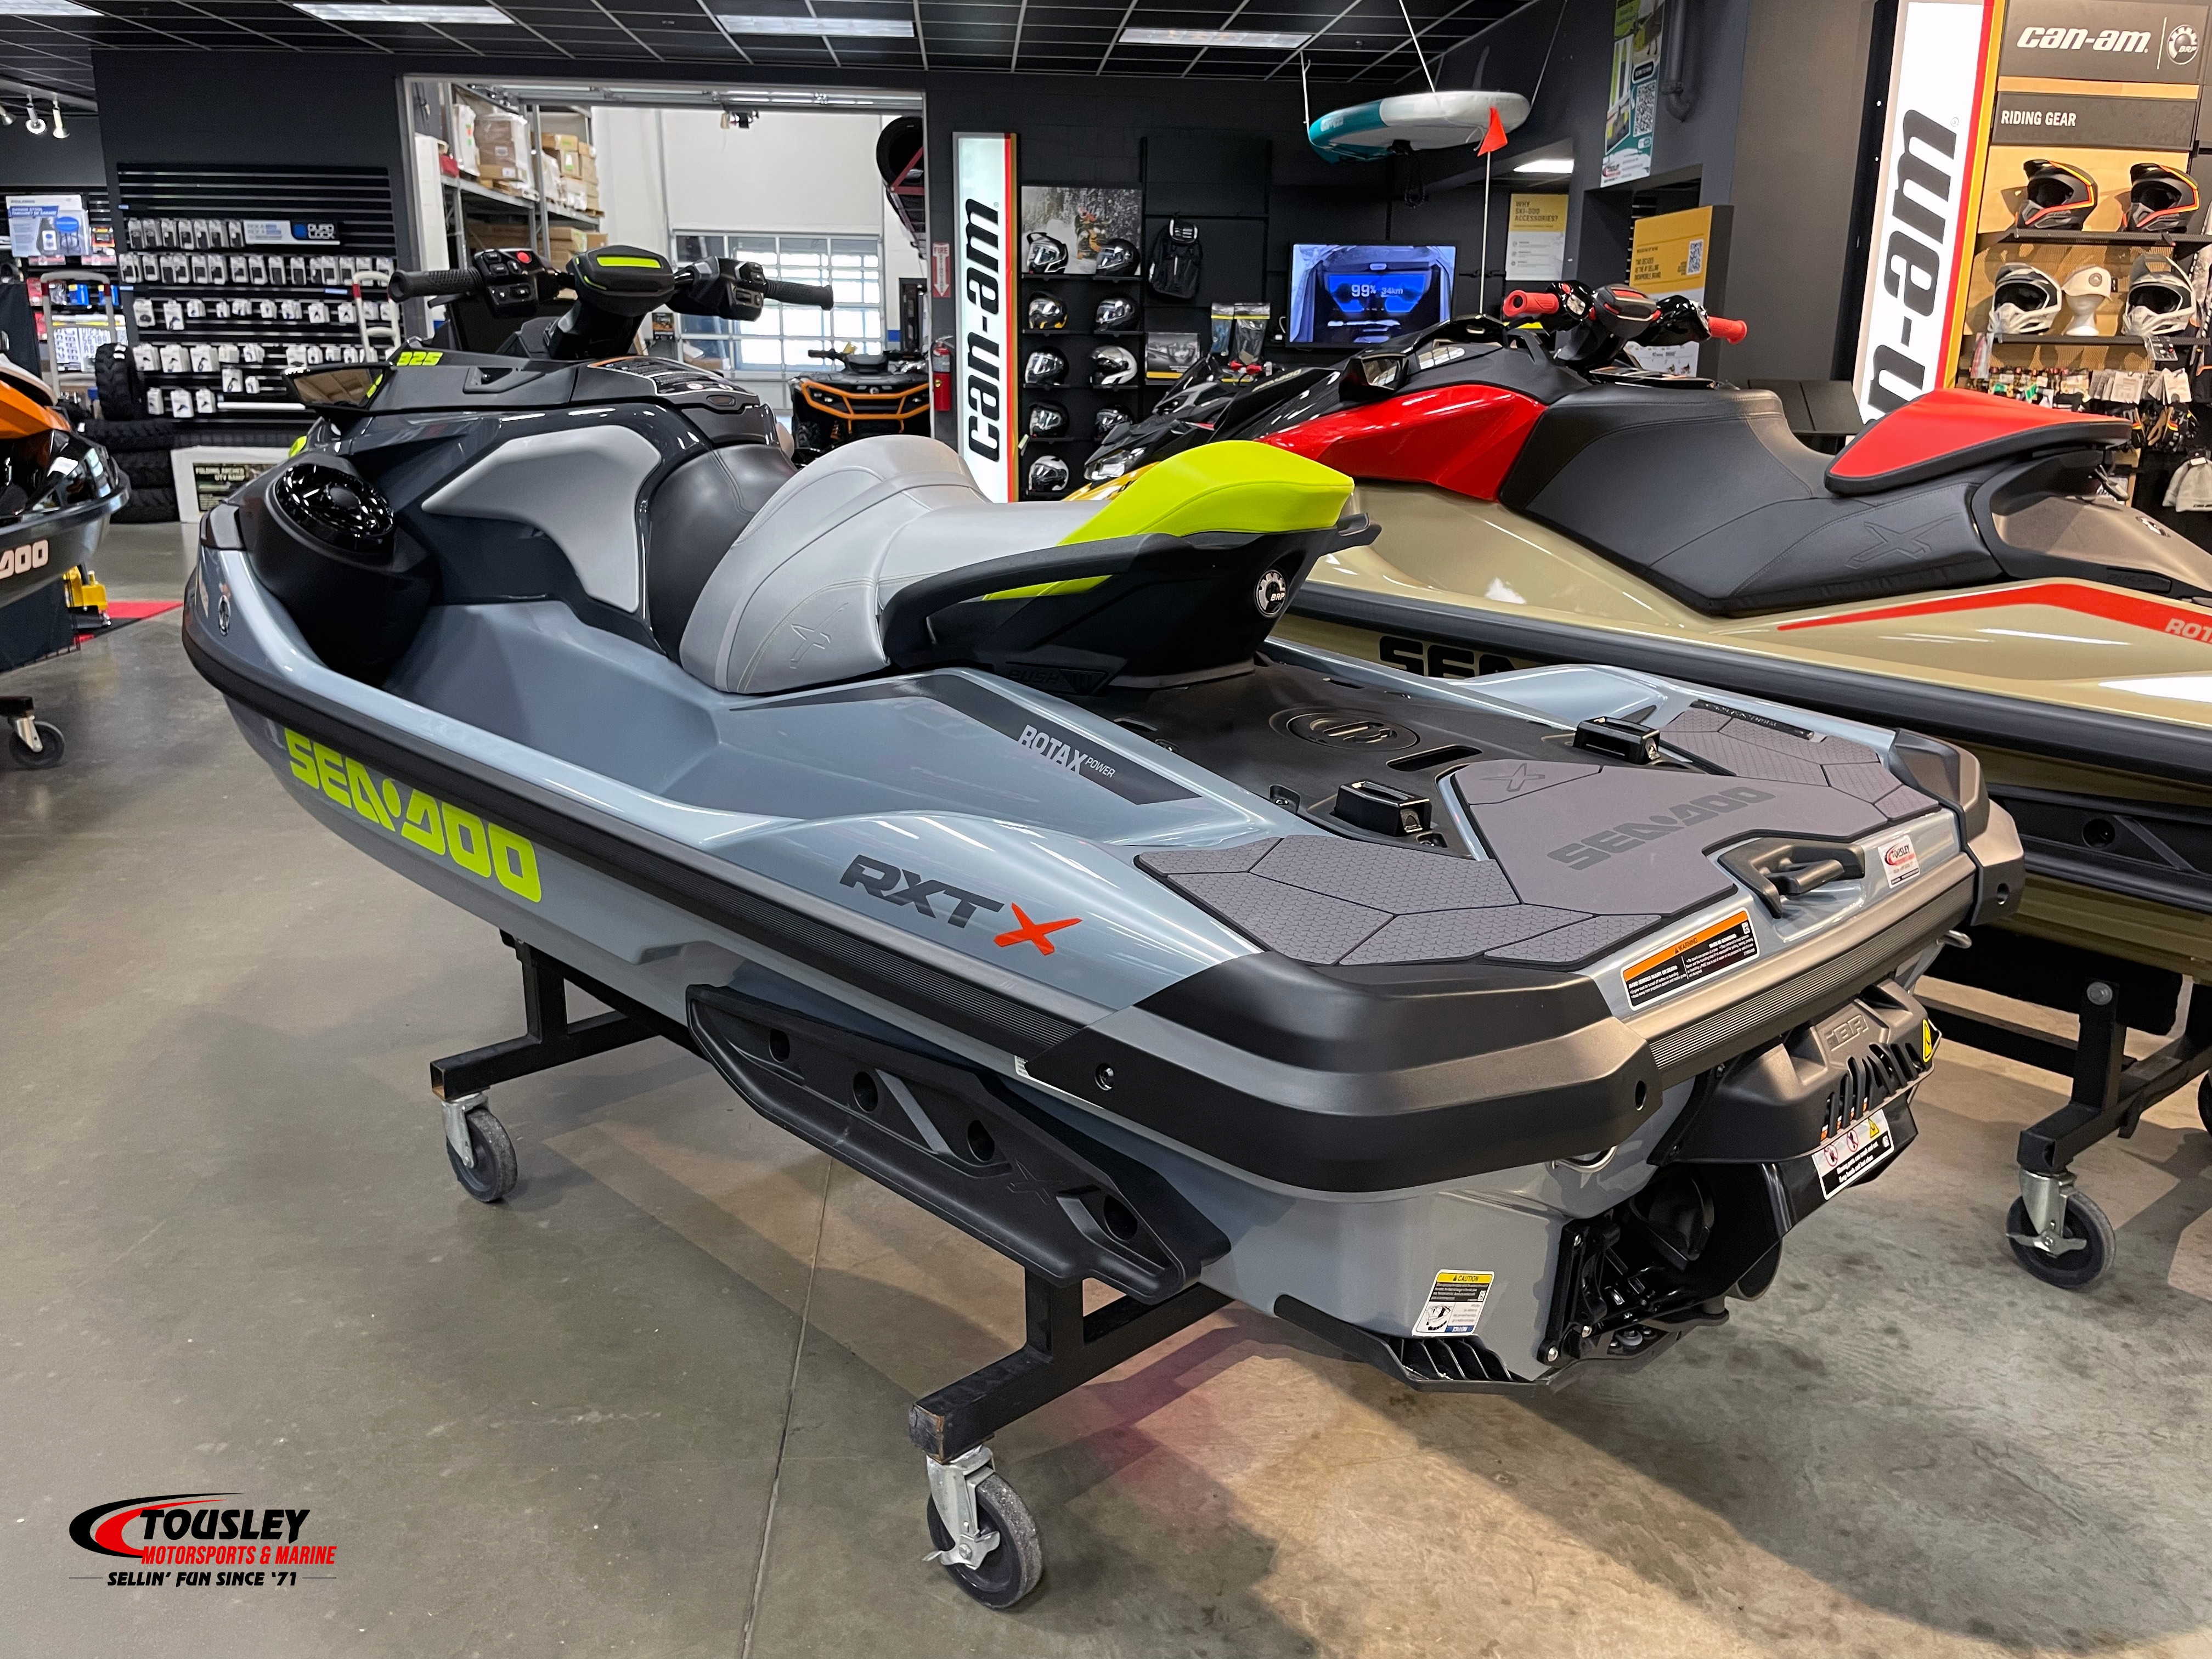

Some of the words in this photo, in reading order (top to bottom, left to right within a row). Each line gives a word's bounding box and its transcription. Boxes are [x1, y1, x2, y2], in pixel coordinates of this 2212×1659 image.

[2001, 110, 2042, 126] RIDING
[2045, 112, 2076, 127] GEAR
[966, 198, 1000, 462] can-am
[396, 352, 443, 366] 325
[1270, 592, 1285, 601] BRP
[2165, 618, 2212, 644] ROT
[1018, 725, 1088, 774] ROTAX
[1085, 757, 1116, 778] POWER
[839, 854, 1005, 928] RXT
